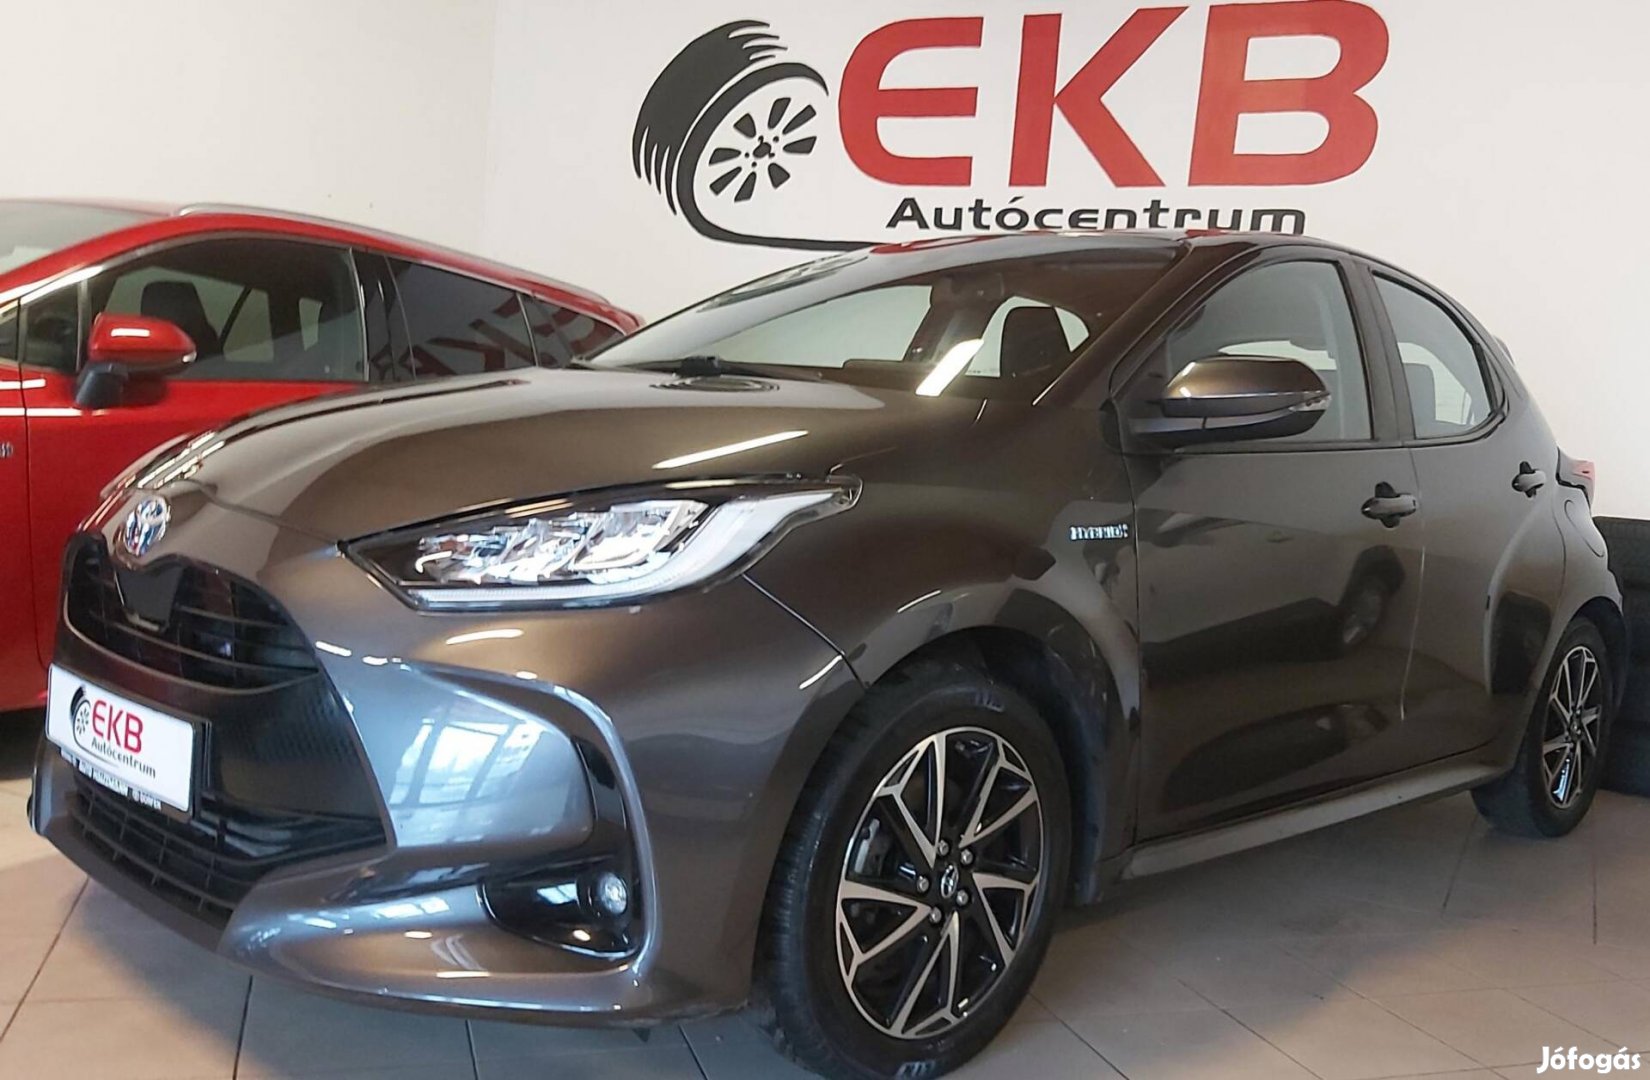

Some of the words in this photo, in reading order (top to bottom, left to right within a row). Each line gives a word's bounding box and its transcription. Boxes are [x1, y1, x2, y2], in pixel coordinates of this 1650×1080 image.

[838, 0, 1389, 188] EKB
[886, 196, 1306, 235] Autócentrum
[92, 699, 144, 754] EKB
[91, 736, 157, 780] Autócentrum
